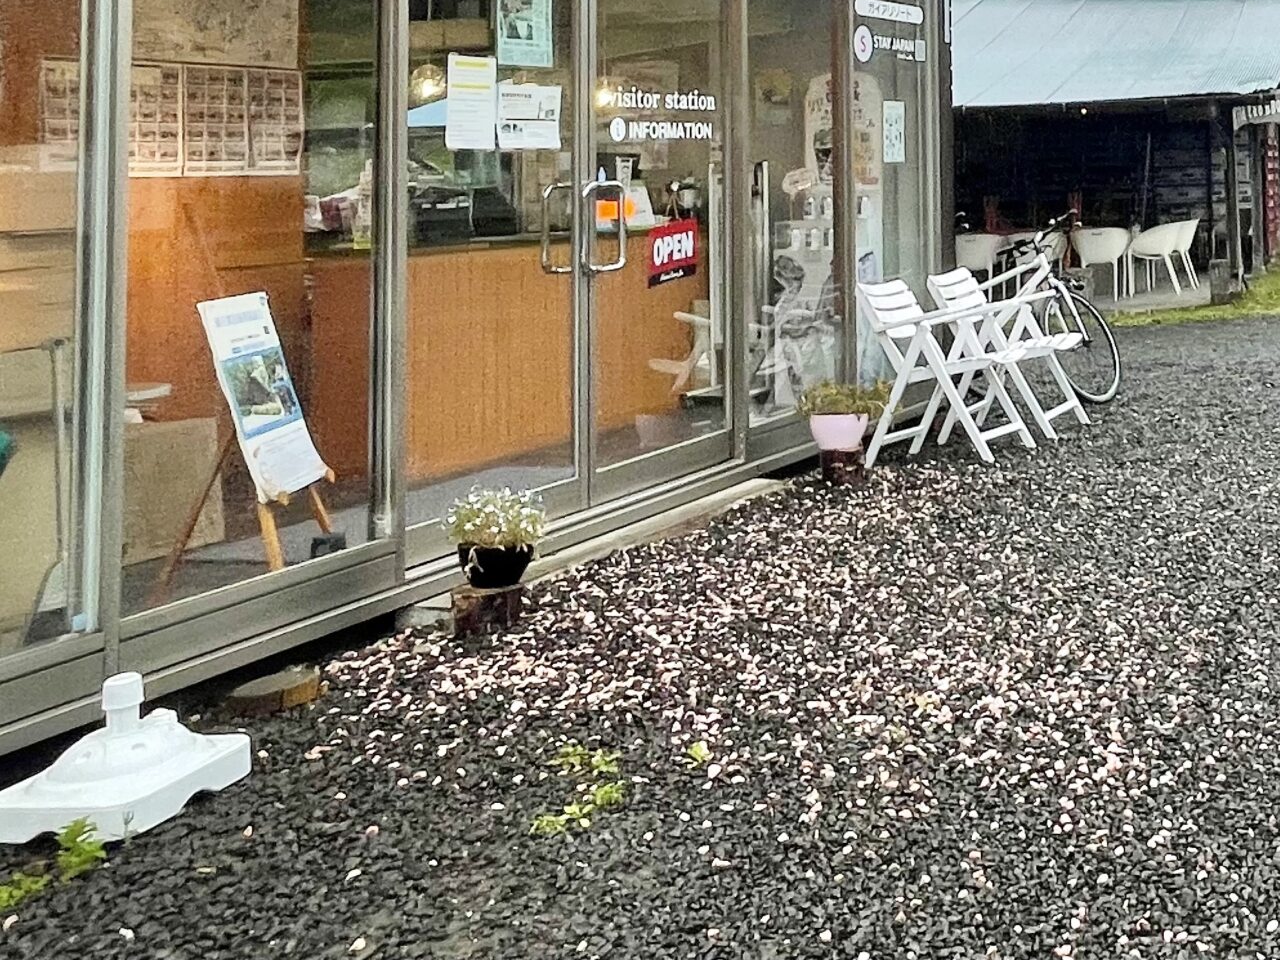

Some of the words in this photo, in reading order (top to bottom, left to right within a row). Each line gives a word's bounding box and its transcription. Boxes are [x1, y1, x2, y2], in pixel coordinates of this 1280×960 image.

[874, 35, 891, 50] STAY
[892, 37, 914, 53] JAPAN
[605, 86, 660, 109] visitor
[665, 89, 716, 111] station
[629, 121, 713, 139] INFORMATION
[653, 230, 694, 267] OPEN
